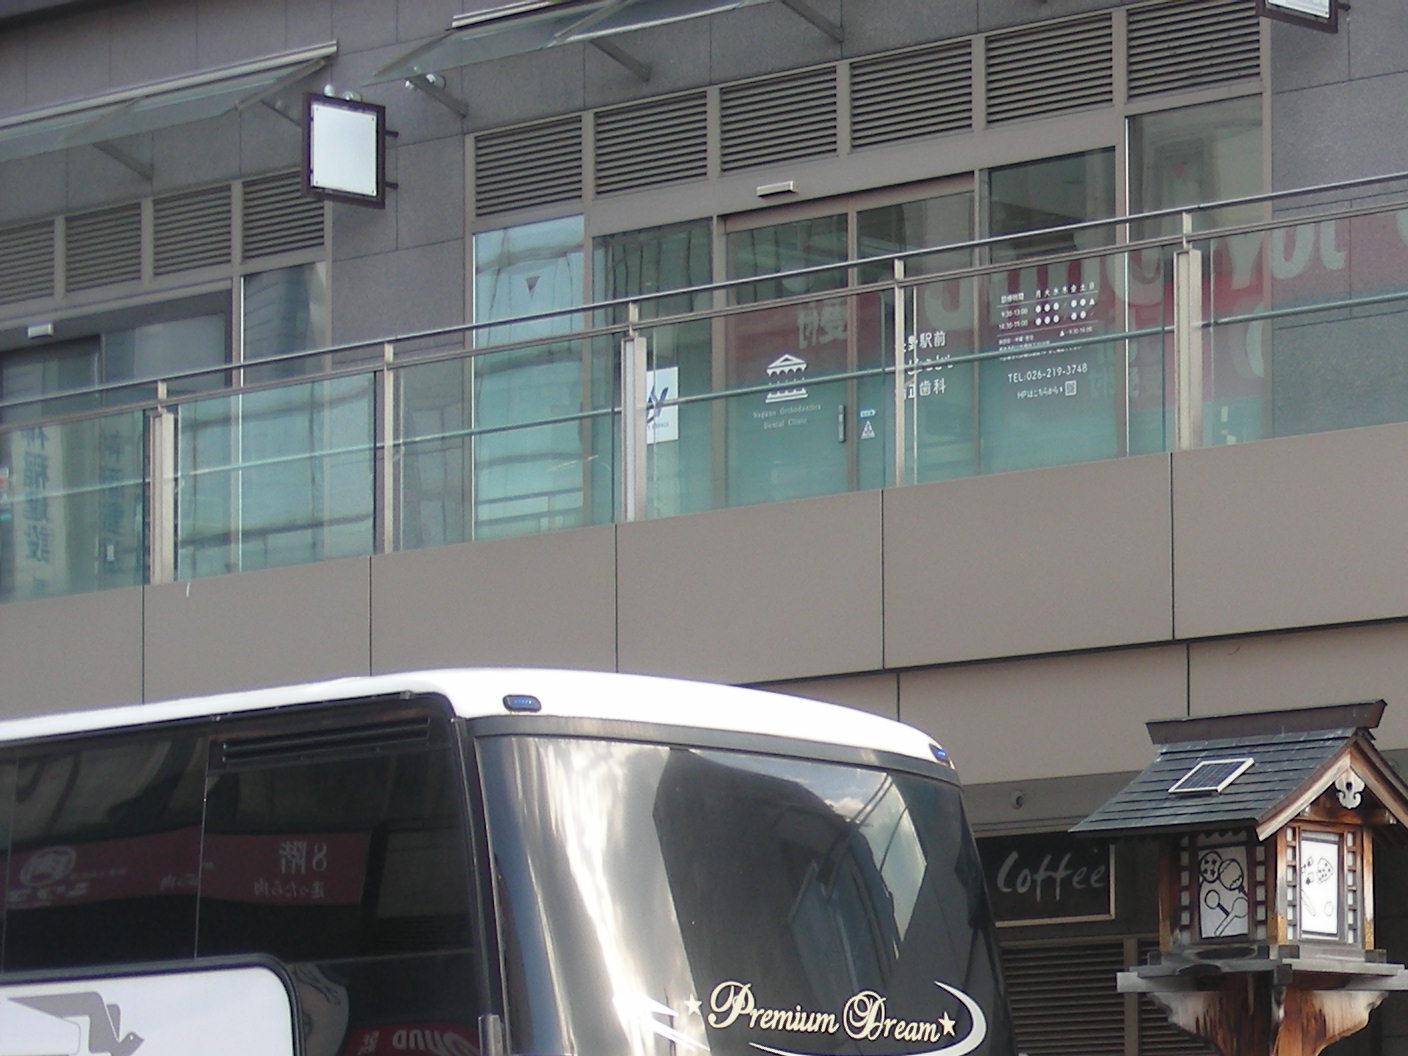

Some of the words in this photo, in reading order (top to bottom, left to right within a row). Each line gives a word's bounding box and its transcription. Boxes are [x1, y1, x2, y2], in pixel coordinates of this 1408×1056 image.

[997, 850, 1106, 902] Coffee
[707, 981, 839, 1031] Premium
[843, 990, 940, 1042] Dream
